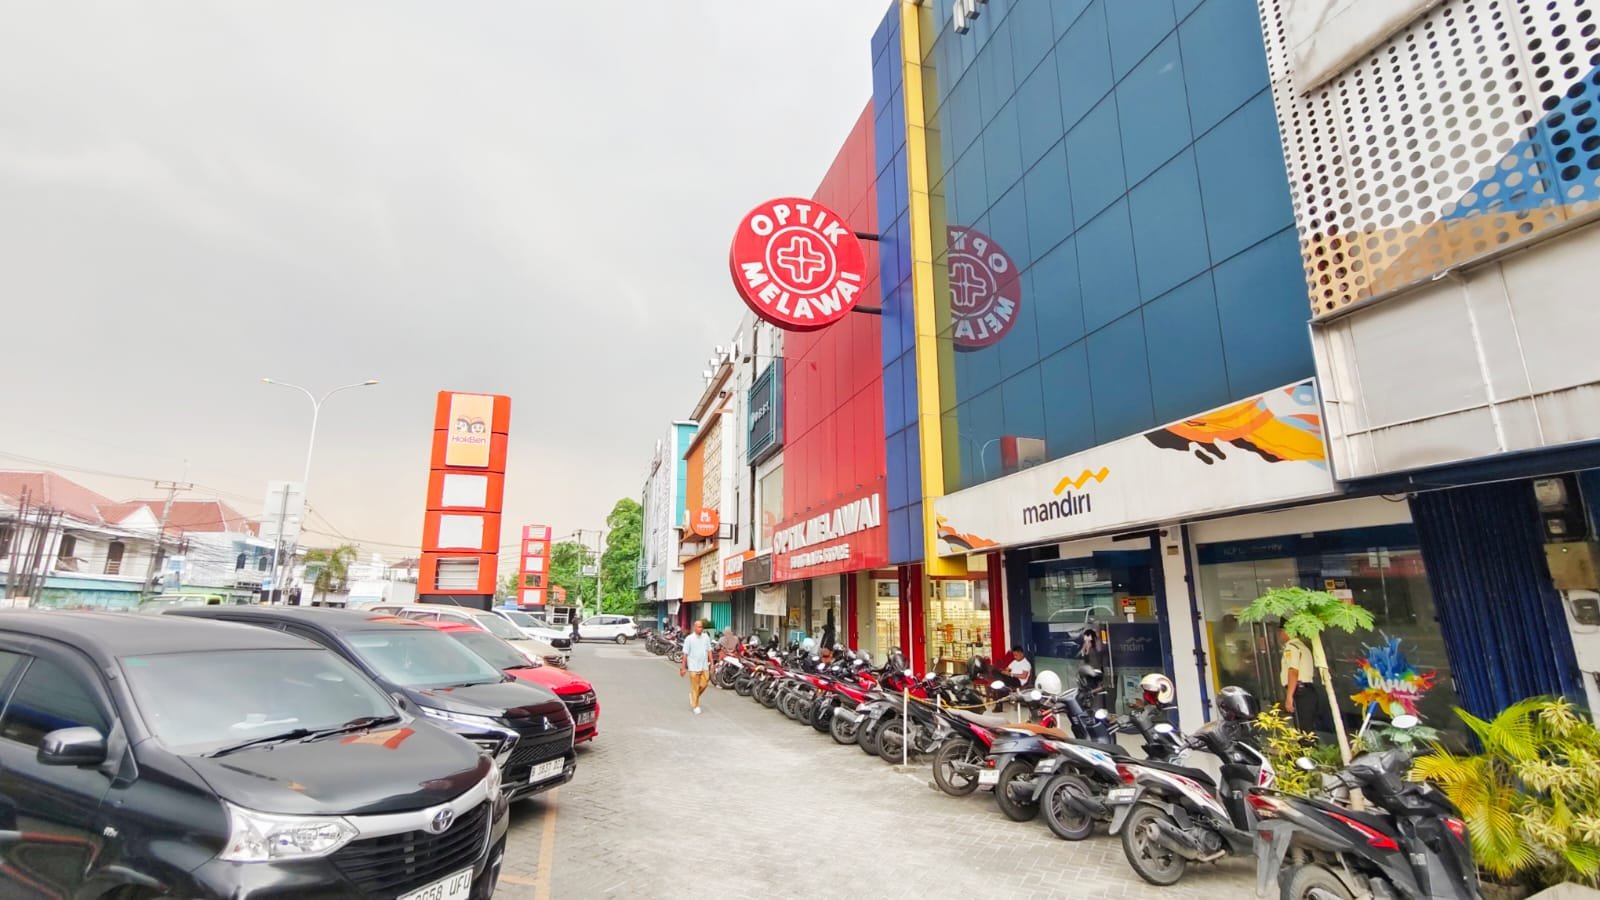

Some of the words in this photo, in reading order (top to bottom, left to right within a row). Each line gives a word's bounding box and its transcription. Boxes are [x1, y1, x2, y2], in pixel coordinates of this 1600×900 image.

[750, 203, 848, 247] OPTIK
[741, 262, 861, 320] MELAWAI
[773, 520, 807, 555] OPTIK
[806, 493, 881, 546] MELAWAI
[1023, 491, 1091, 525] mandiri
